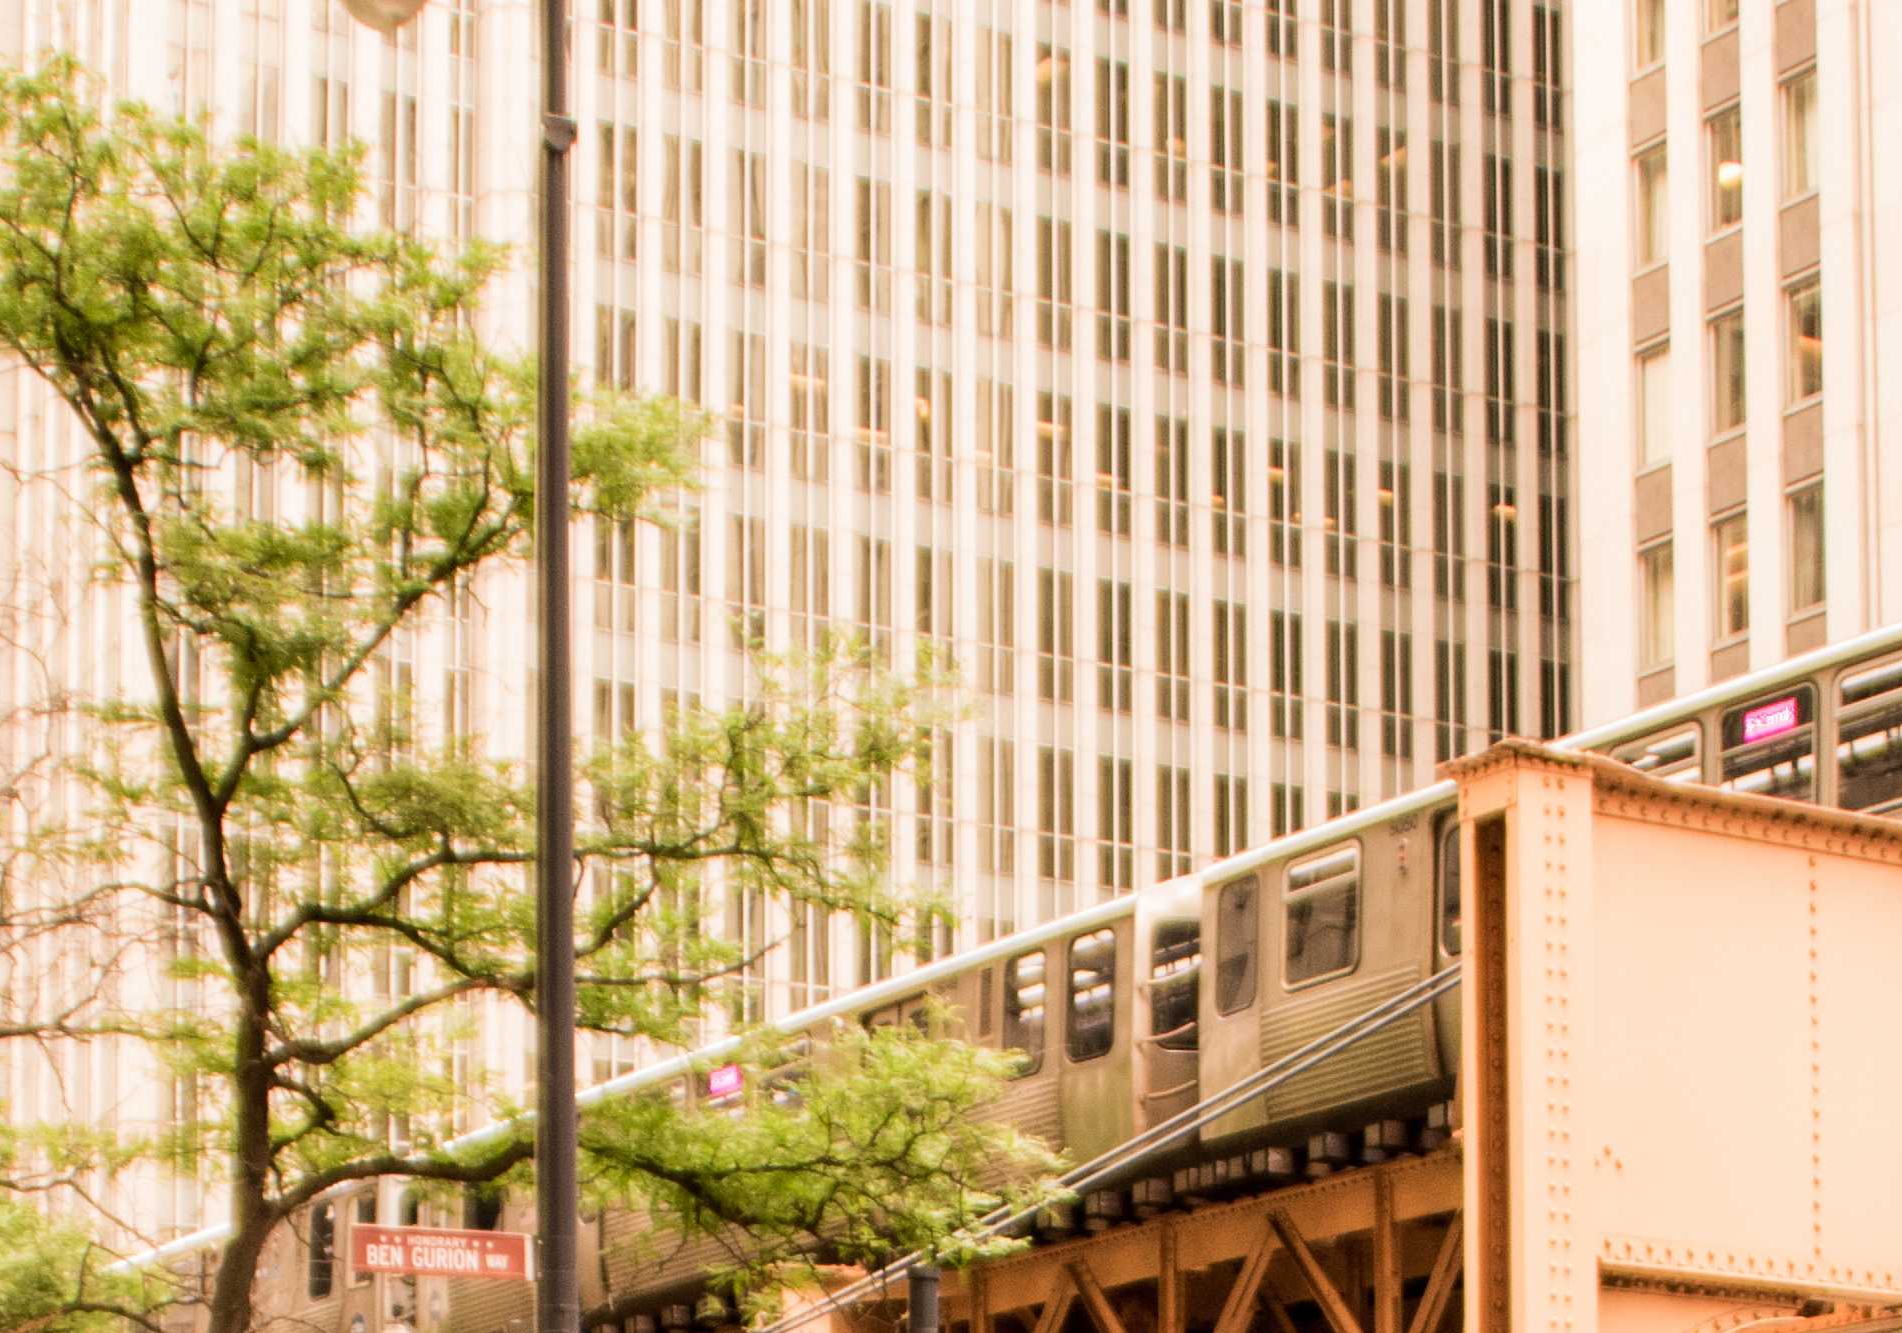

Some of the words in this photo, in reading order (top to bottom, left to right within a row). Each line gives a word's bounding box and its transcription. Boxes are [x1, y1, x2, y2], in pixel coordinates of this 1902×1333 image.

[366, 1244, 403, 1267] BEN
[412, 1246, 480, 1270] GURION
[485, 1254, 508, 1270] WAY
